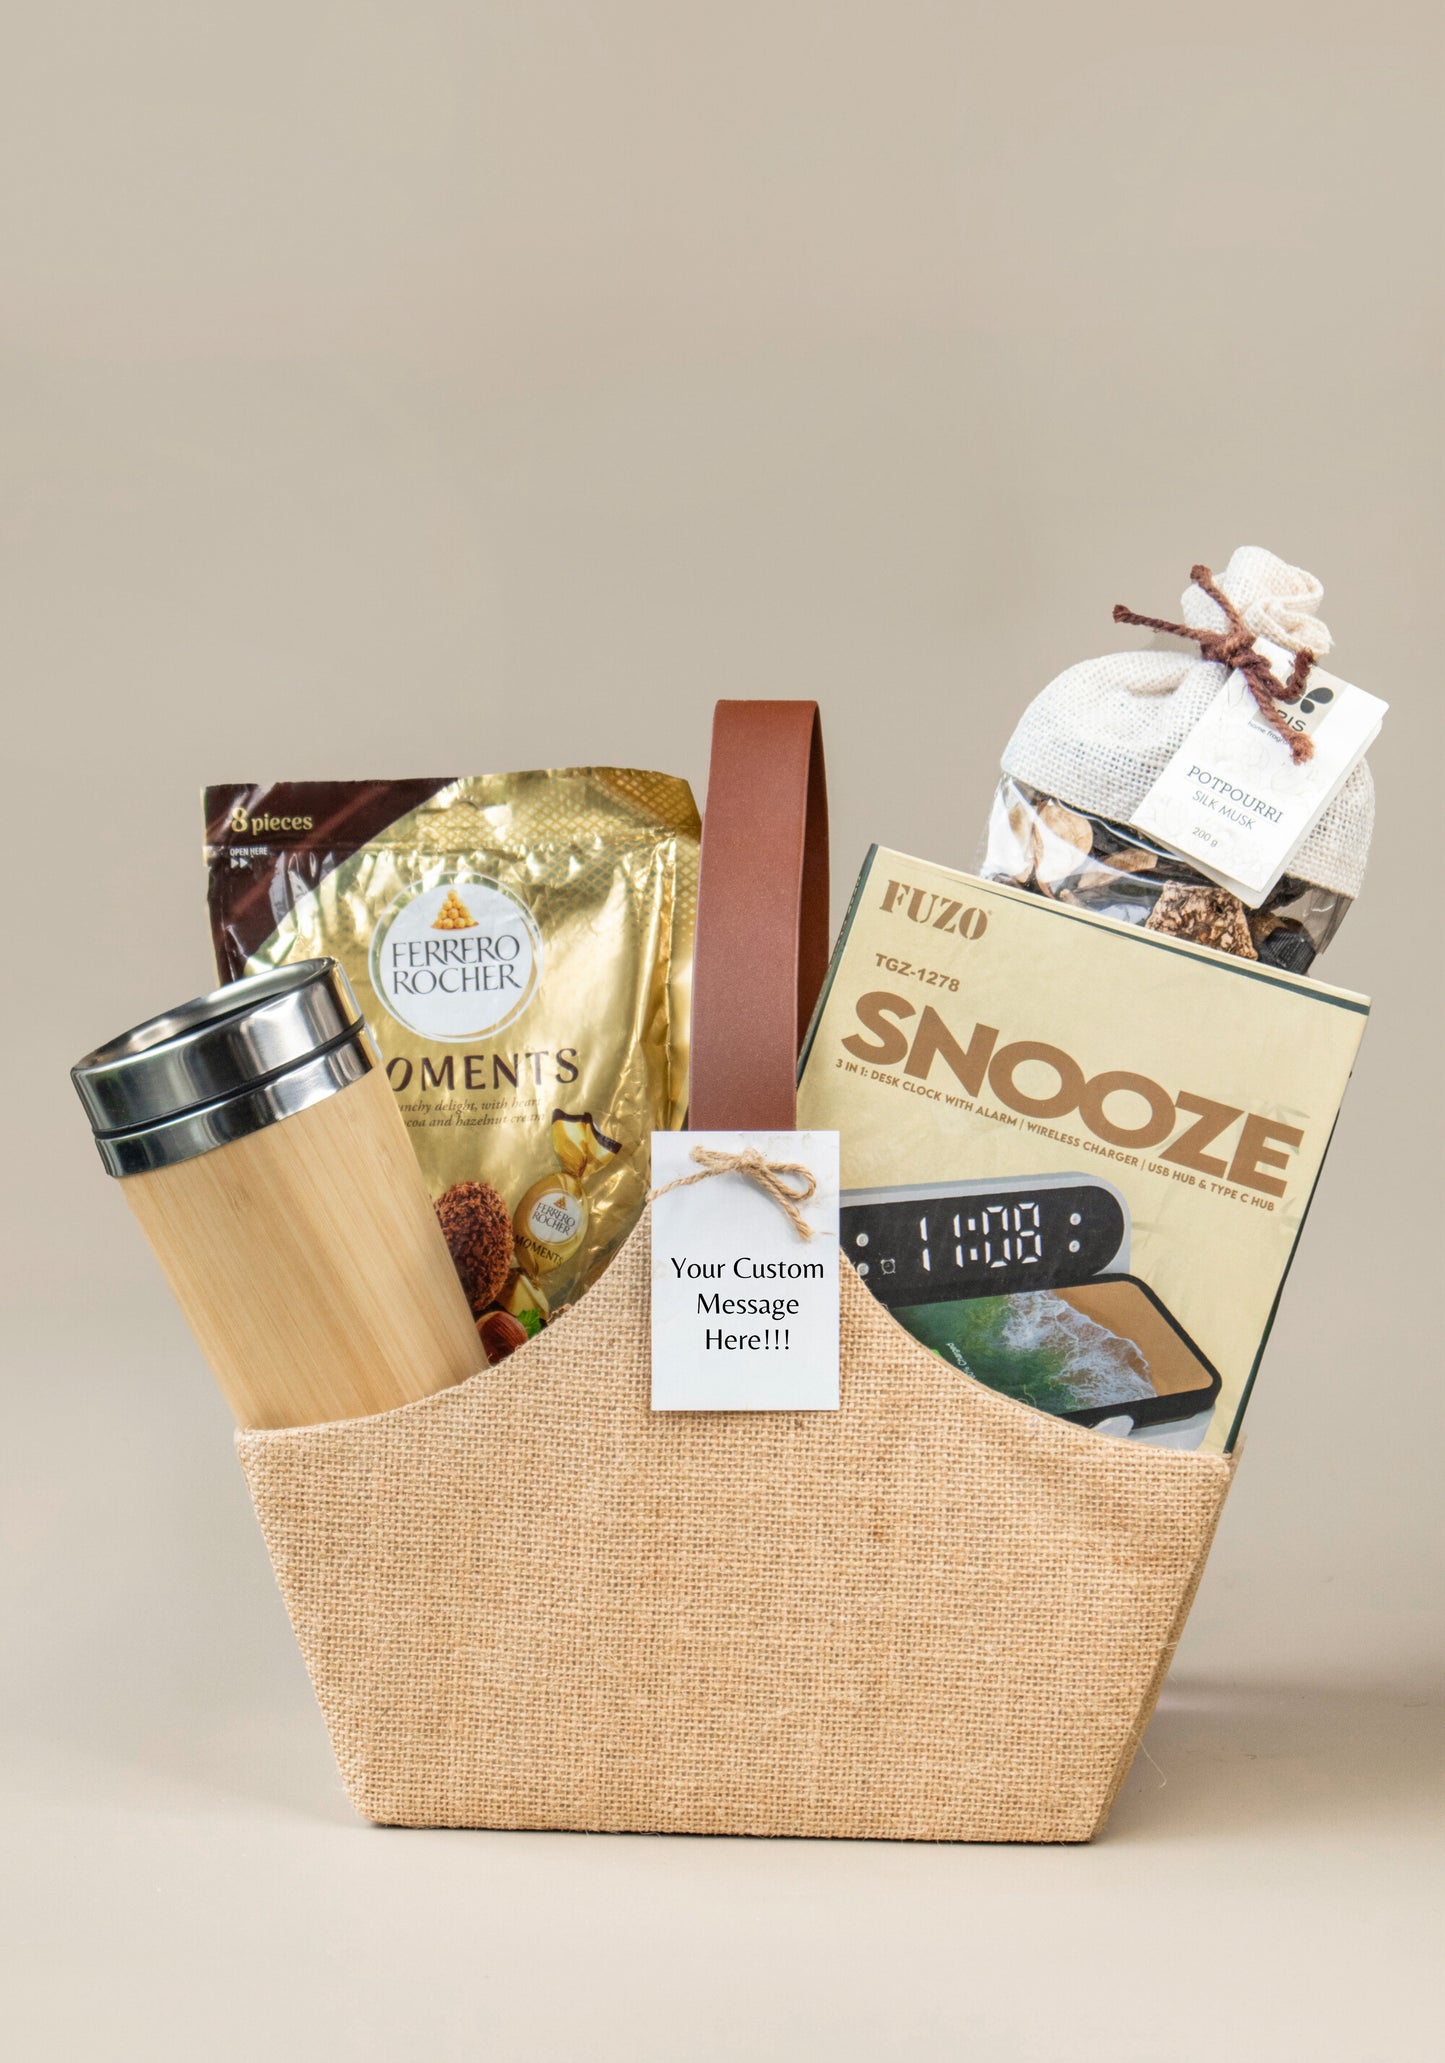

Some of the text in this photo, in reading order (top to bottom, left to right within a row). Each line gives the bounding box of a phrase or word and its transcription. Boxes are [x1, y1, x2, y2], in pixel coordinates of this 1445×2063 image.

[1187, 765, 1283, 823] POTPOURRI
[231, 807, 313, 836] 8 pieces
[1192, 790, 1256, 830] SILK MUSK
[1192, 826, 1211, 841] 200
[229, 846, 268, 857] OPEN HERE
[879, 879, 988, 940] FUZO
[392, 934, 520, 968] FERRERO
[393, 964, 522, 995] ROCHER
[875, 953, 960, 992] TGZ-1278
[386, 1048, 579, 1092] OMENTS
[399, 1100, 432, 1115] unchy
[435, 1099, 478, 1116] delight,
[482, 1097, 508, 1111] with
[841, 991, 1305, 1198] SNOOZE
[429, 1114, 453, 1127] and
[456, 1112, 507, 1128] hazelnut
[835, 1058, 843, 1069] 3
[844, 1062, 858, 1074] IN
[860, 1066, 868, 1077] 1:
[870, 1069, 900, 1088] DESK
[902, 1081, 942, 1102] CLOCK
[944, 1094, 974, 1112] WITH
[975, 1105, 1018, 1127] ALARM
[1027, 1121, 1080, 1147] WIRELESS
[1083, 1140, 1139, 1167] CHARGER
[1148, 1162, 1169, 1178] USB
[1172, 1171, 1197, 1187] HUB
[1198, 1179, 1207, 1190] &
[1210, 1183, 1239, 1199] TYPE
[1240, 1192, 1249, 1204] C
[1250, 1197, 1275, 1212] HUB
[532, 1211, 571, 1236] ROCHER
[536, 1202, 576, 1228] FERRERO
[514, 1233, 564, 1264] MOMENTS
[919, 1202, 1042, 1272] 11:08
[671, 1257, 824, 1279] Your Custom
[697, 1293, 800, 1320] Message
[706, 1328, 790, 1350] Here!!!
